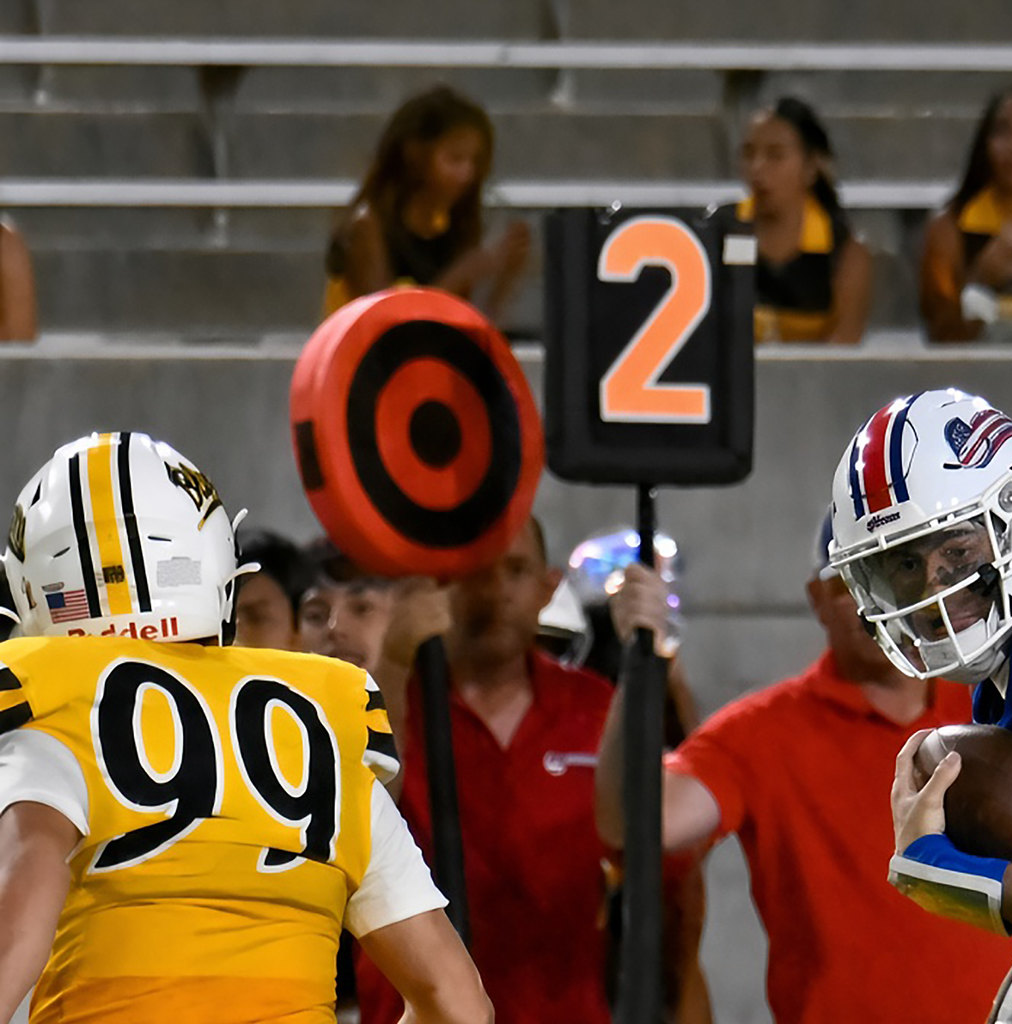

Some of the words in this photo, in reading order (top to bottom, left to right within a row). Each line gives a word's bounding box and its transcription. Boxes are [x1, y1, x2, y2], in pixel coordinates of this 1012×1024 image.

[598, 214, 712, 424] 2
[68, 617, 178, 640] ddell
[87, 657, 341, 875] 99
